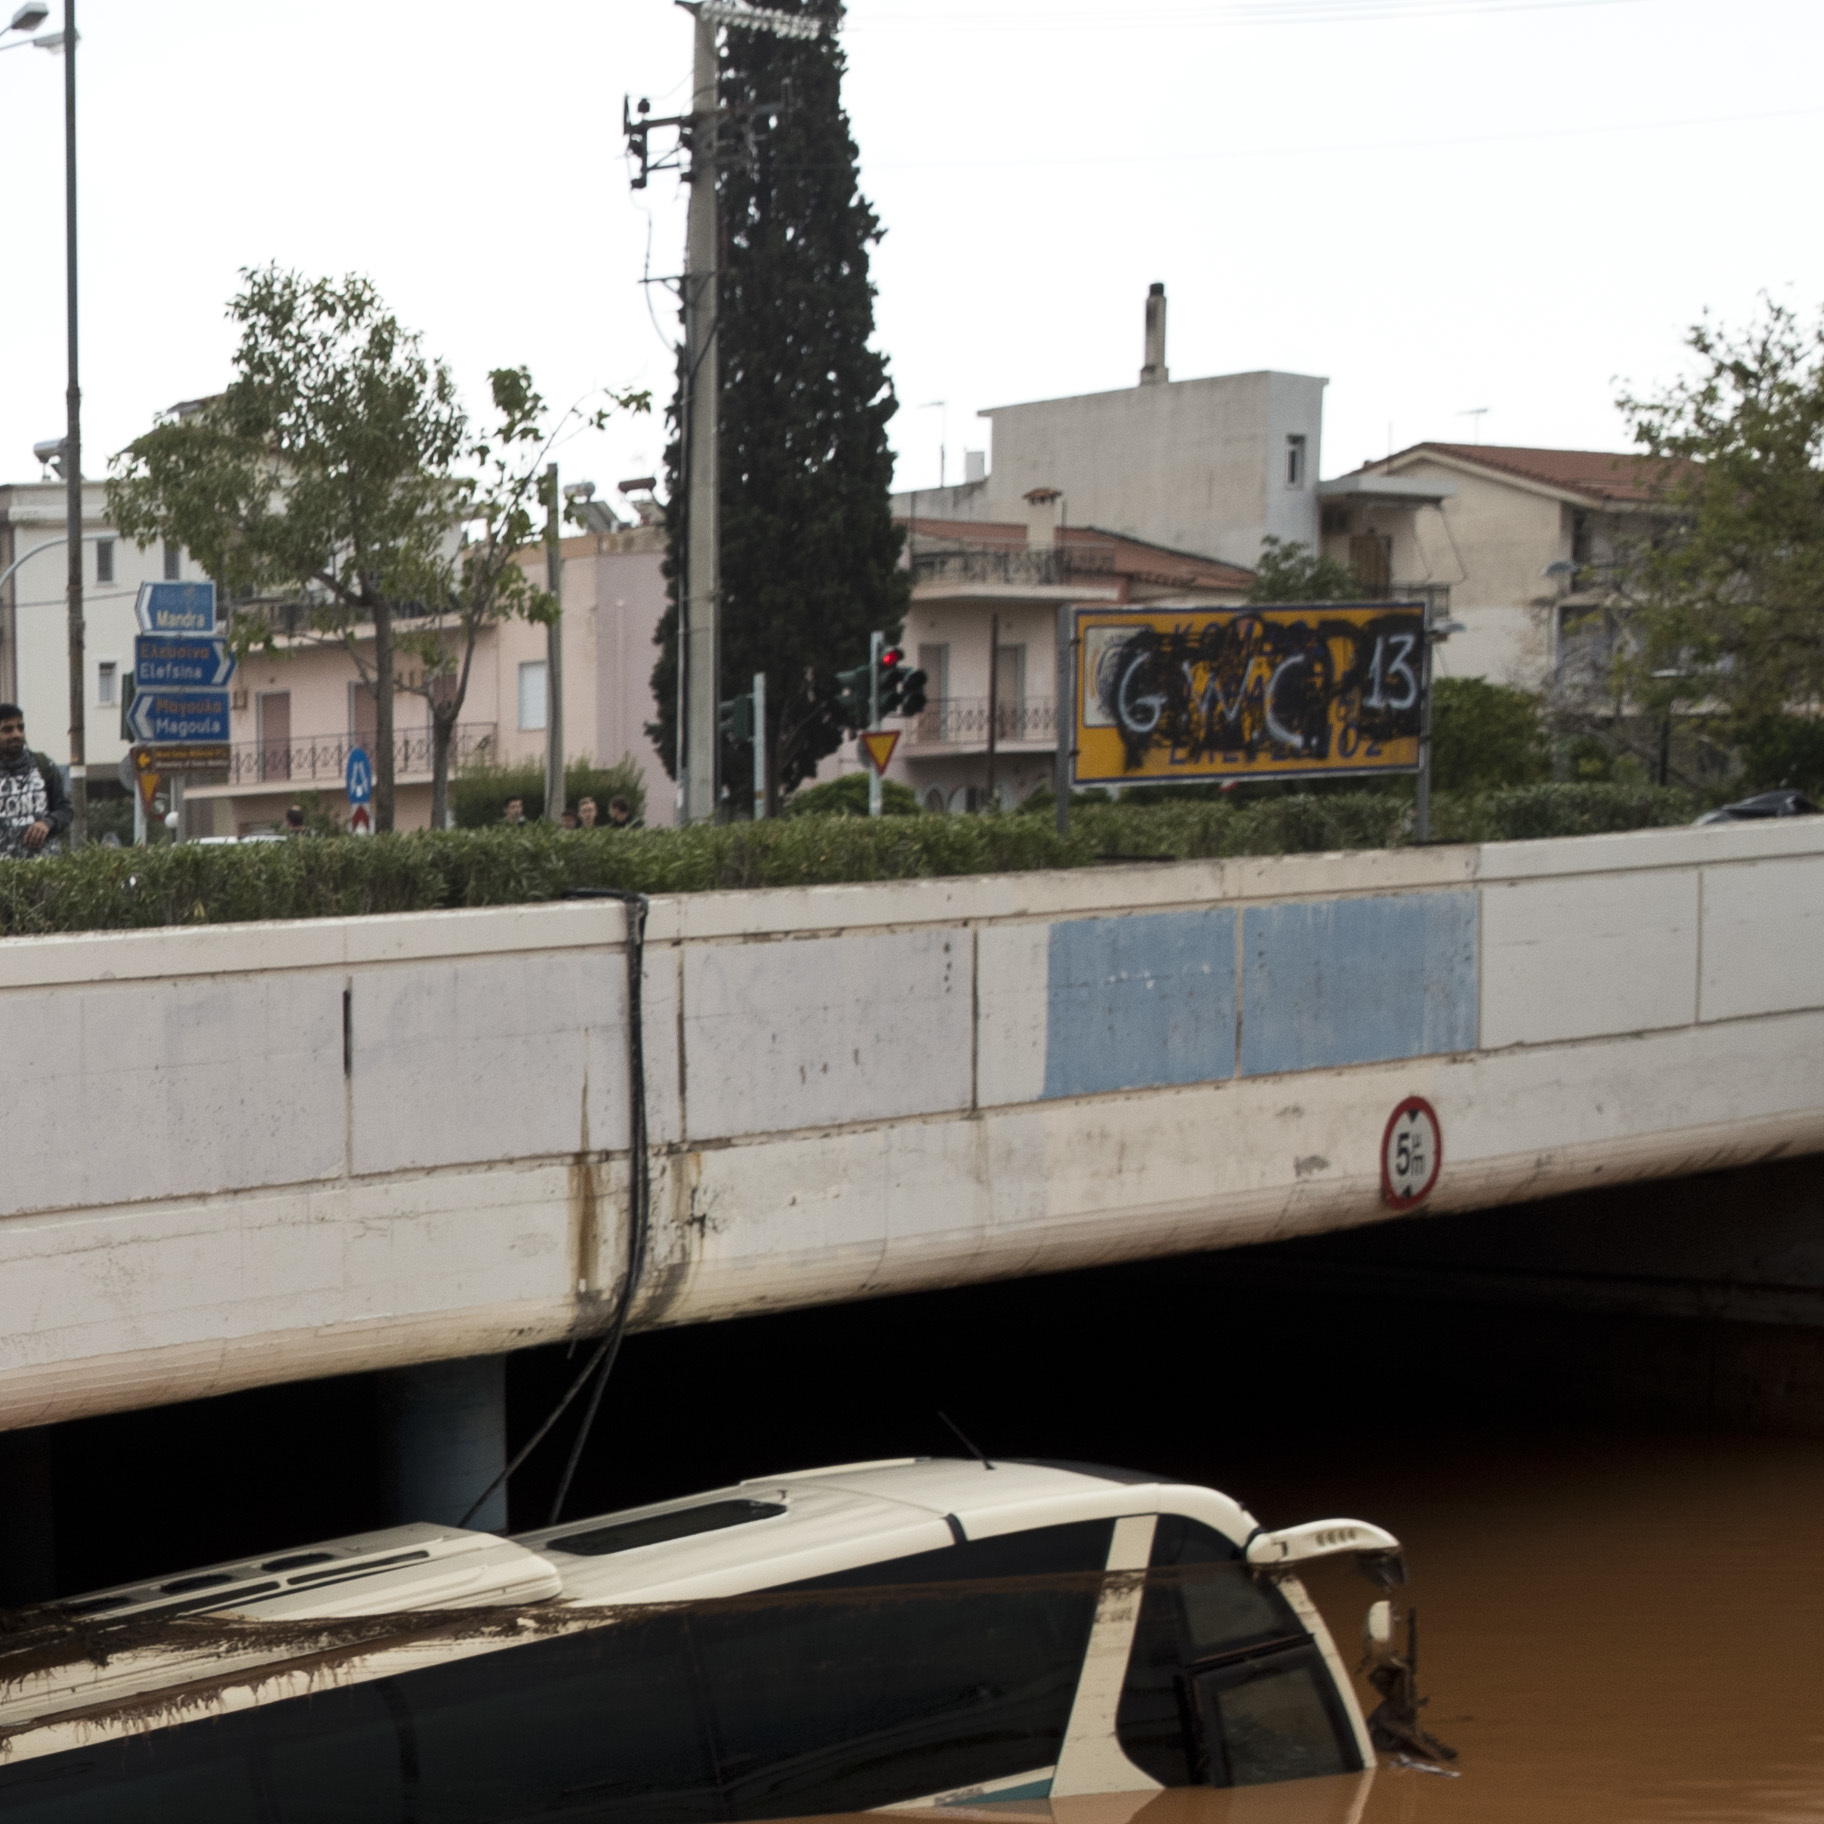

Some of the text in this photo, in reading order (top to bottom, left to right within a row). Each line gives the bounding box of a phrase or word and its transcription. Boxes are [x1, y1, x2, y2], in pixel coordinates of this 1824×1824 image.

[156, 608, 206, 628] Mandra
[140, 661, 203, 680] Elefsina
[1361, 632, 1419, 711] 13
[155, 717, 221, 737] Magoula
[1395, 1131, 1410, 1177] 5
